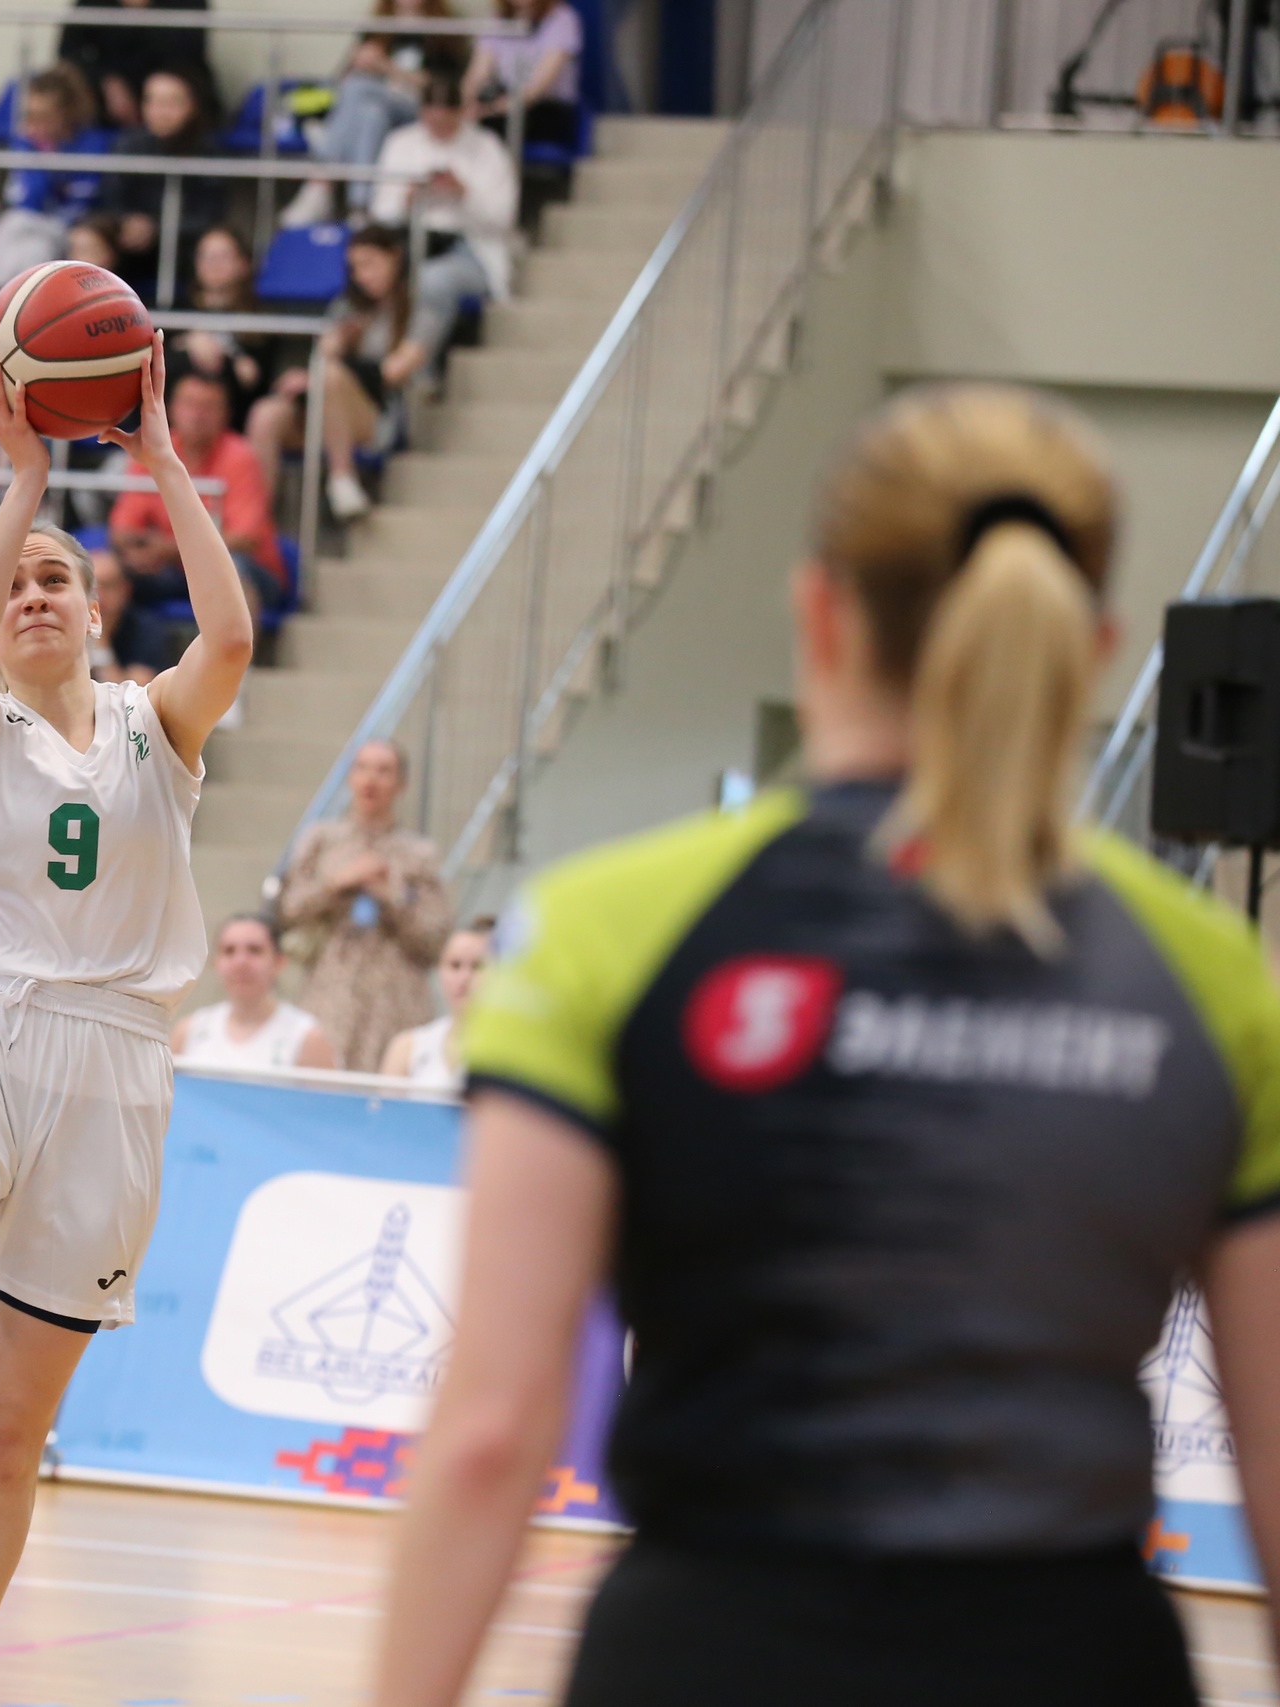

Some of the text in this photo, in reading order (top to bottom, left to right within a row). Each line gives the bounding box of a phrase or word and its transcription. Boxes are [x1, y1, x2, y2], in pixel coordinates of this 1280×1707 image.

[85, 312, 146, 337] molten
[47, 803, 100, 891] 9
[257, 1347, 442, 1388] BELARUSKA
